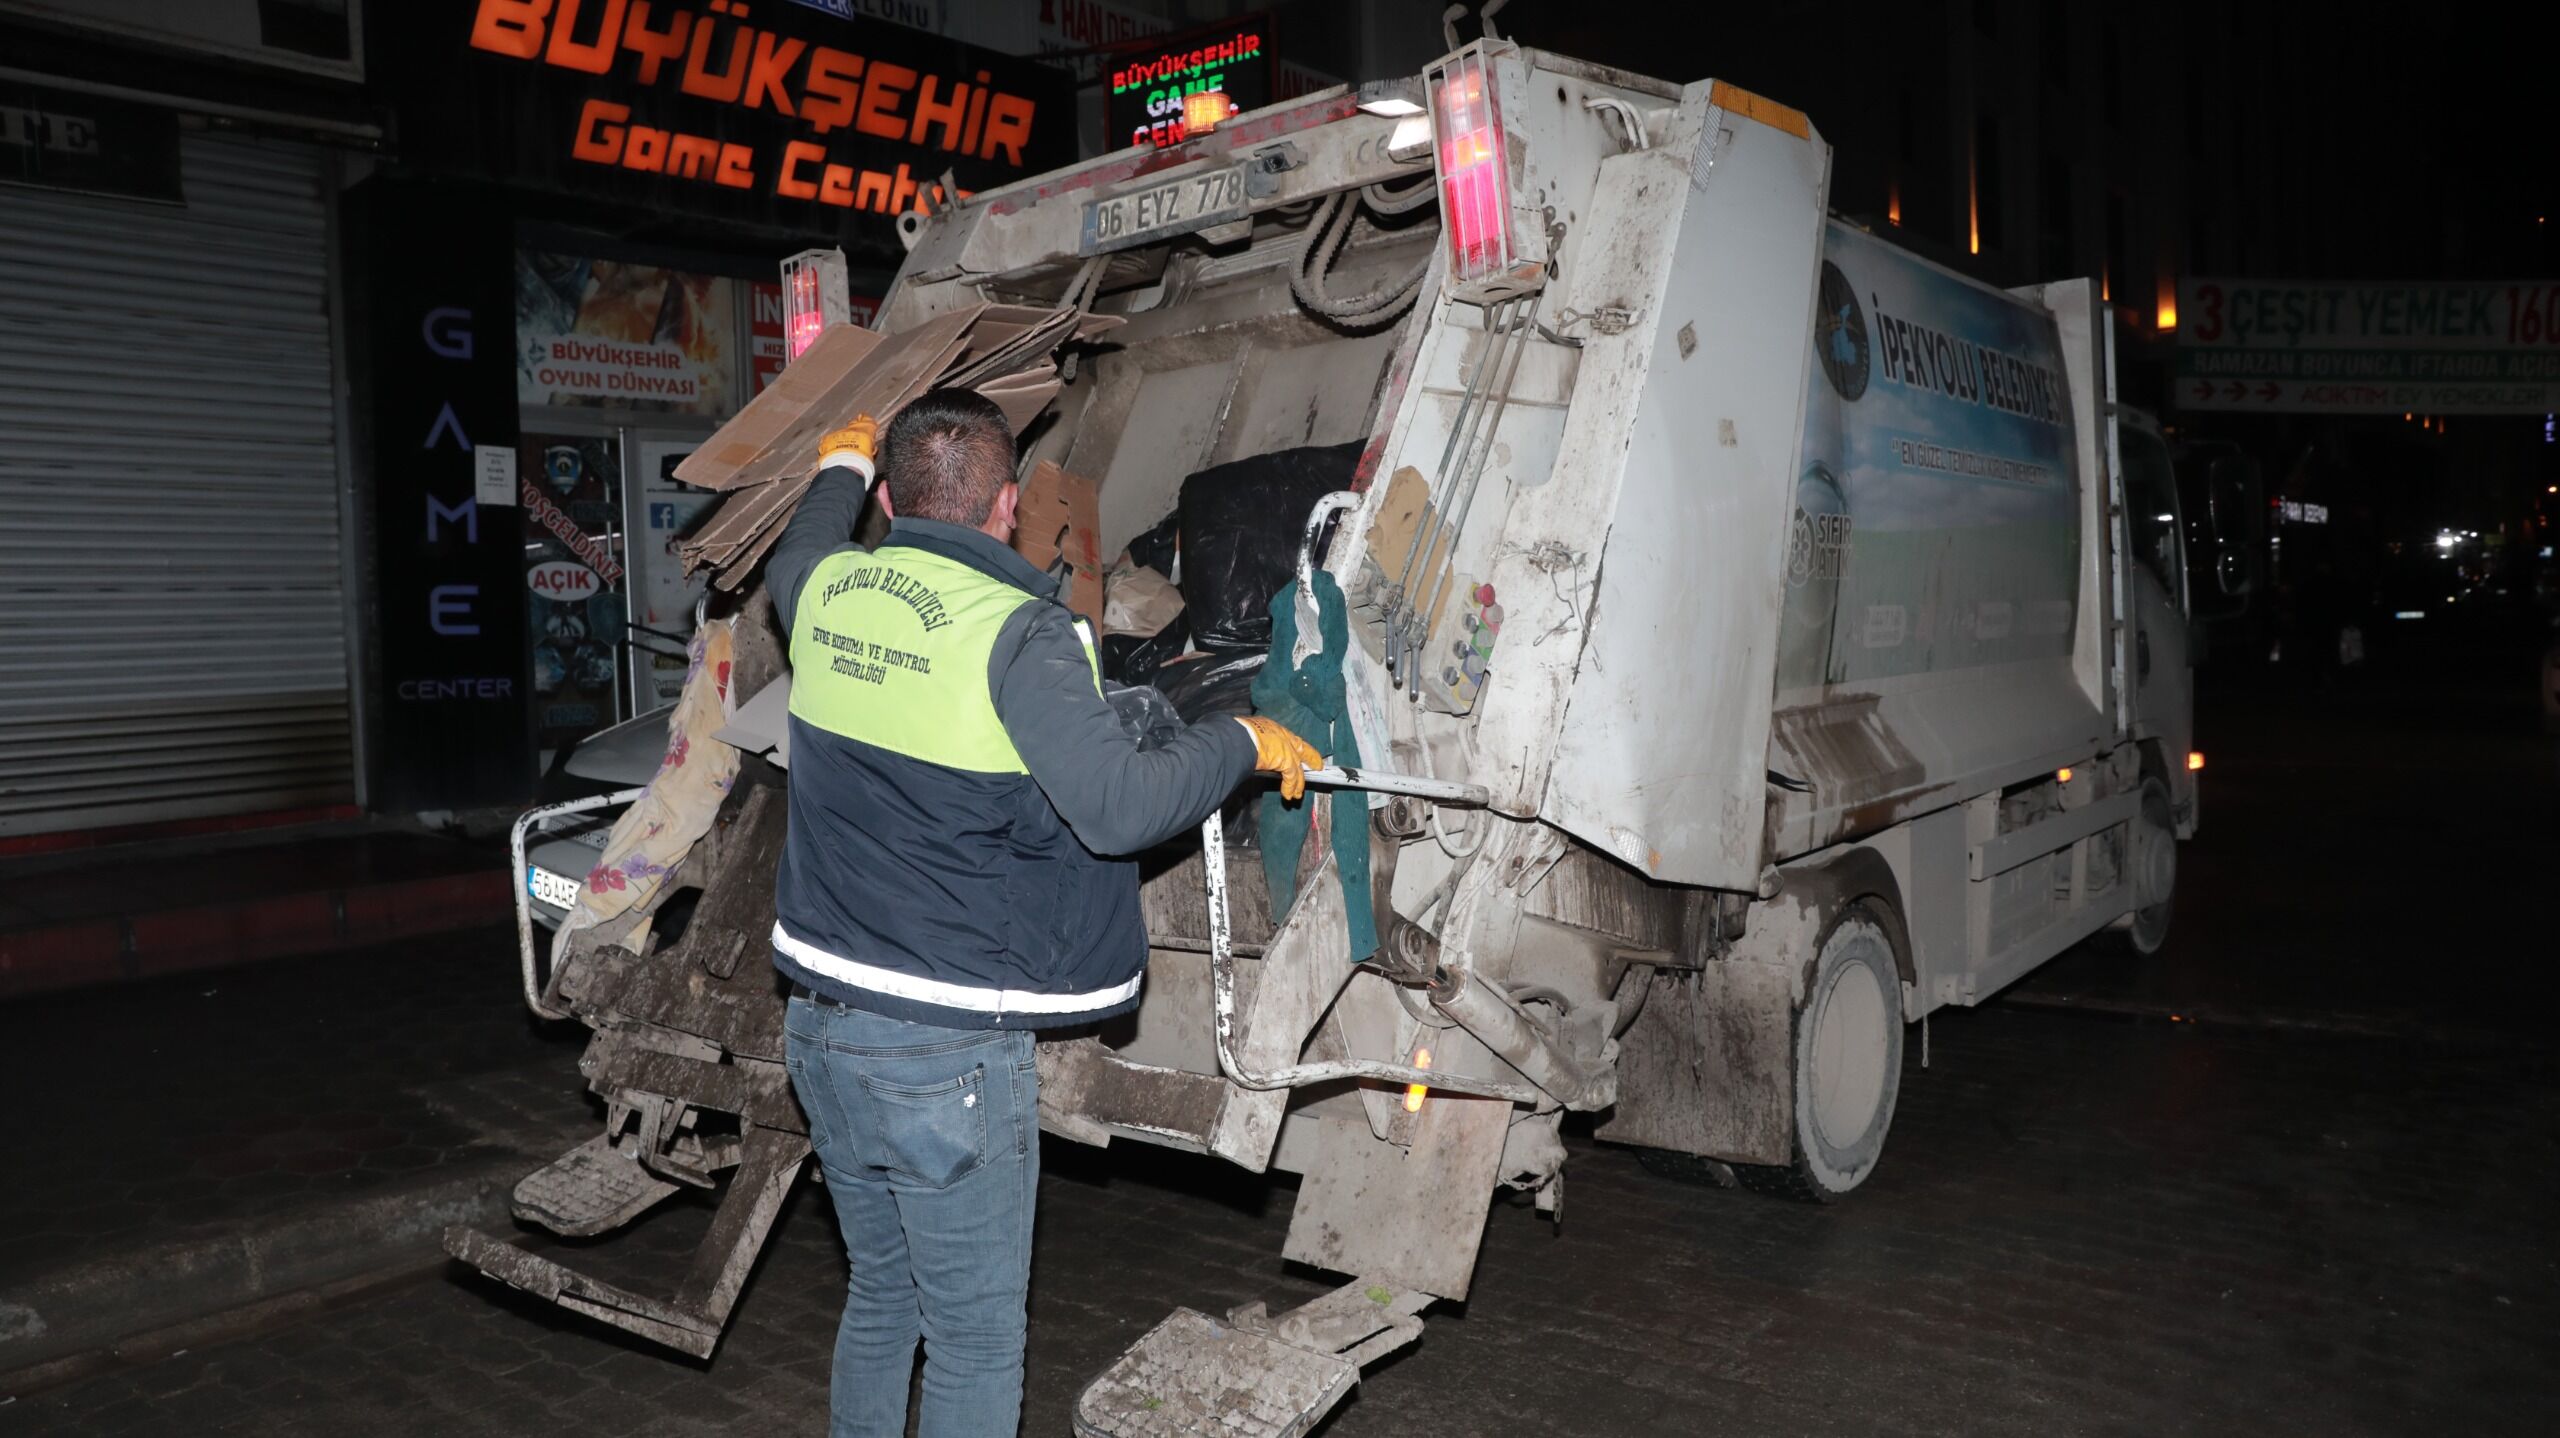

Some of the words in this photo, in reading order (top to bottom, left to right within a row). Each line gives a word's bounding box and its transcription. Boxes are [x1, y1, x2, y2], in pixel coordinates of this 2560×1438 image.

[1113, 33, 1260, 94] BÜYÜKŞEHİR
[571, 98, 756, 190] Game
[1096, 200, 1123, 238] 06
[1138, 187, 1180, 229] EYZ
[1197, 172, 1242, 213] 778
[2194, 284, 2225, 342] 3
[2230, 287, 2346, 346] ÇEŞİT
[2356, 287, 2497, 337] YEMEK
[552, 340, 681, 369] BÜYÜKŞEHİR
[1872, 291, 1979, 402] İPEKYOLU
[539, 368, 601, 388] OYUN
[607, 371, 695, 395] DÜNYASI
[1917, 440, 1947, 470] GÜZEL
[1818, 514, 1852, 545] SIFIR
[533, 568, 592, 595] AÇIK
[878, 567, 954, 632] BELEDİYESİ
[831, 632, 864, 656] KORUMA
[868, 643, 882, 660] VE
[883, 648, 932, 674] KONTROL
[396, 677, 513, 701] CENTER
